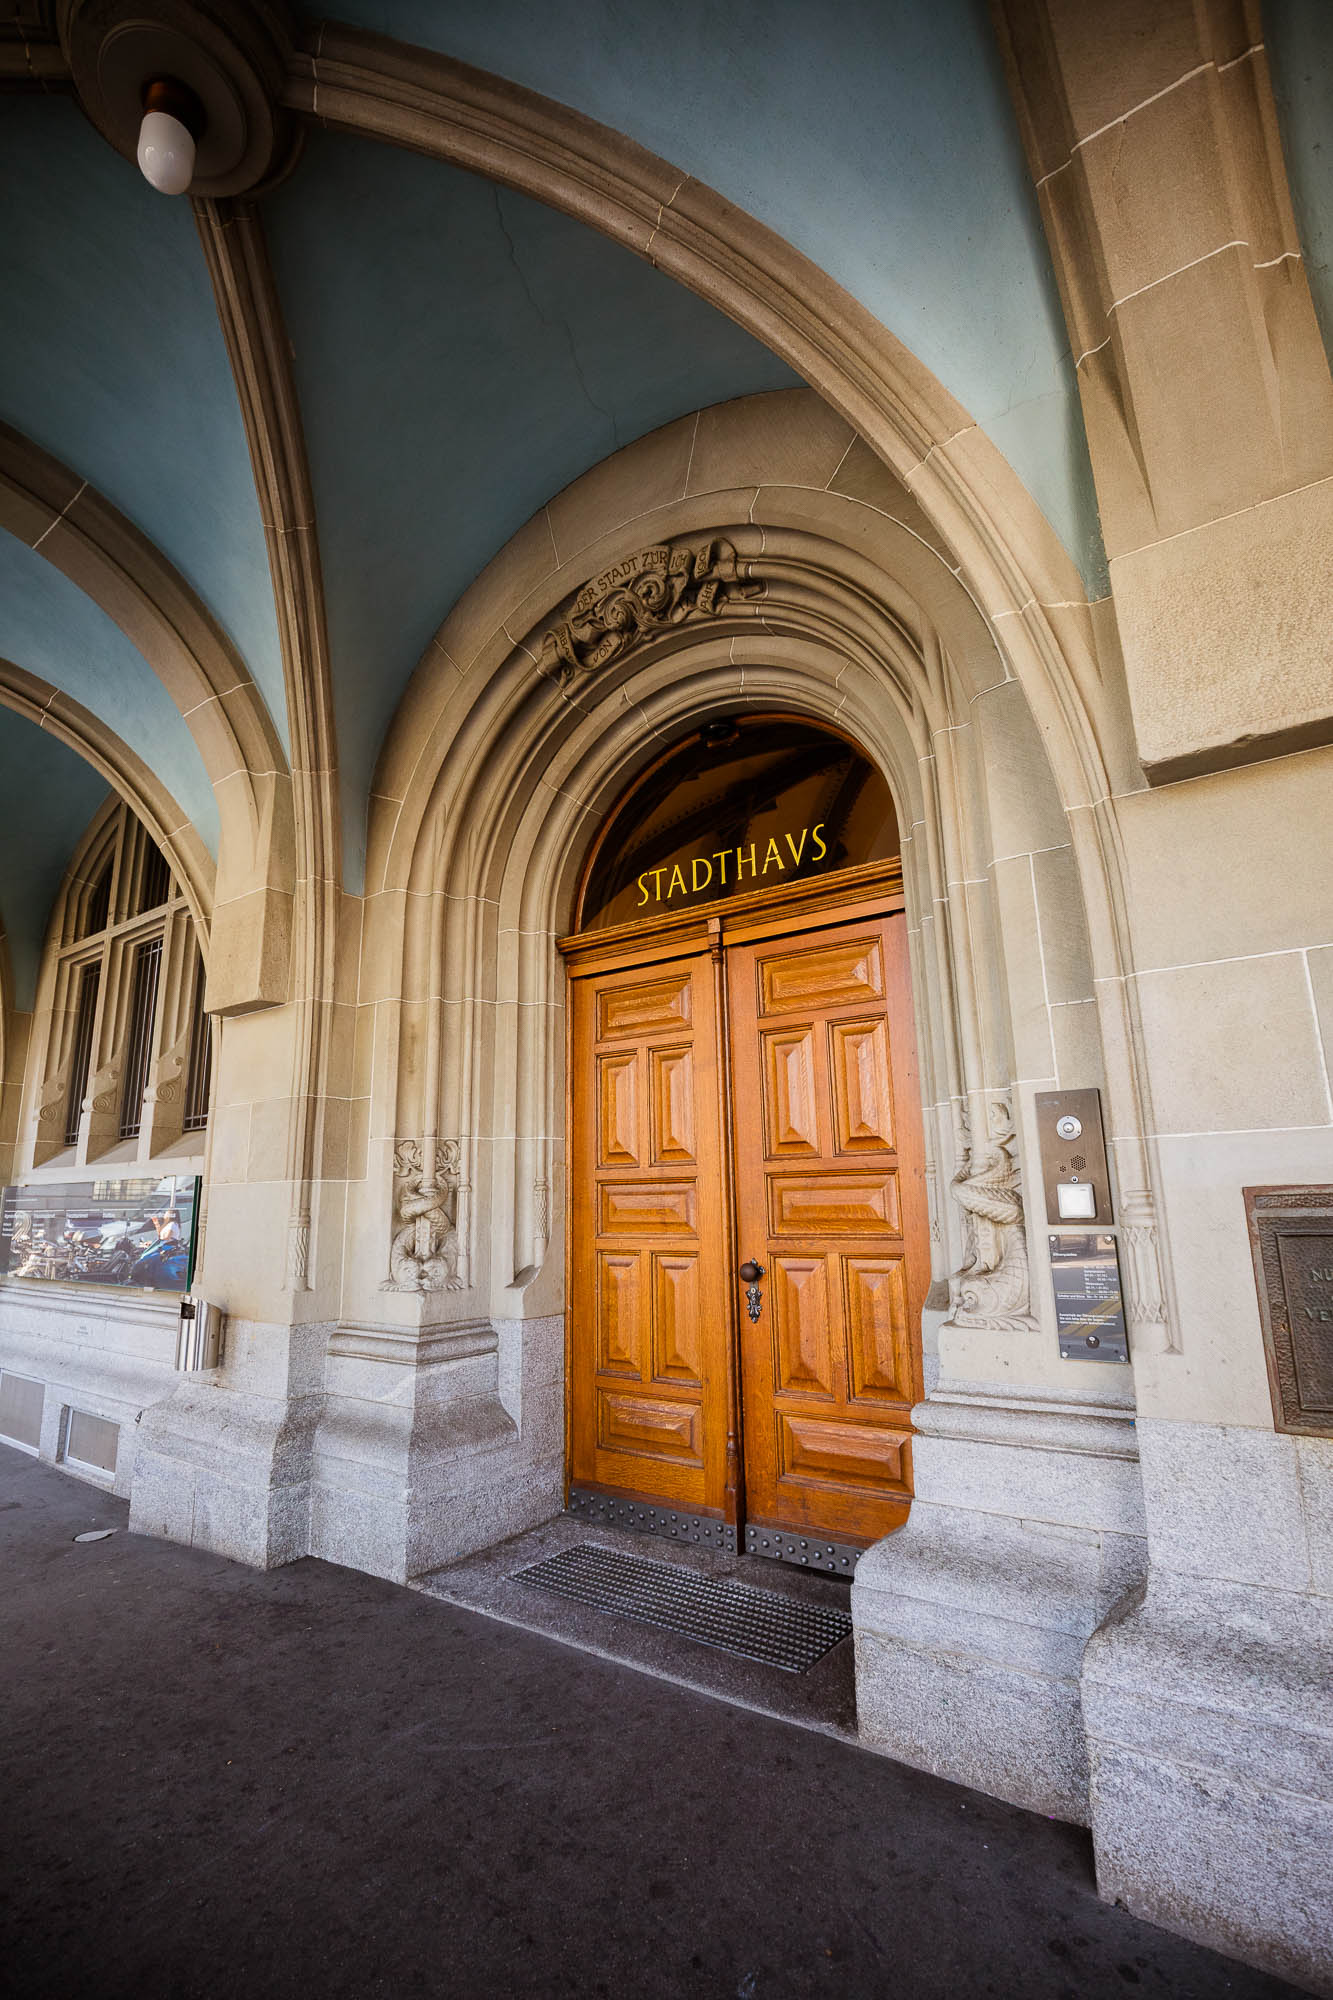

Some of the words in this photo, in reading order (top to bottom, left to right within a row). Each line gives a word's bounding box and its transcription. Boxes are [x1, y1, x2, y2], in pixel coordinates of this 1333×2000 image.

[597, 556, 638, 592] STADT
[593, 639, 613, 663] VON
[637, 823, 827, 906] STADTHAVS
